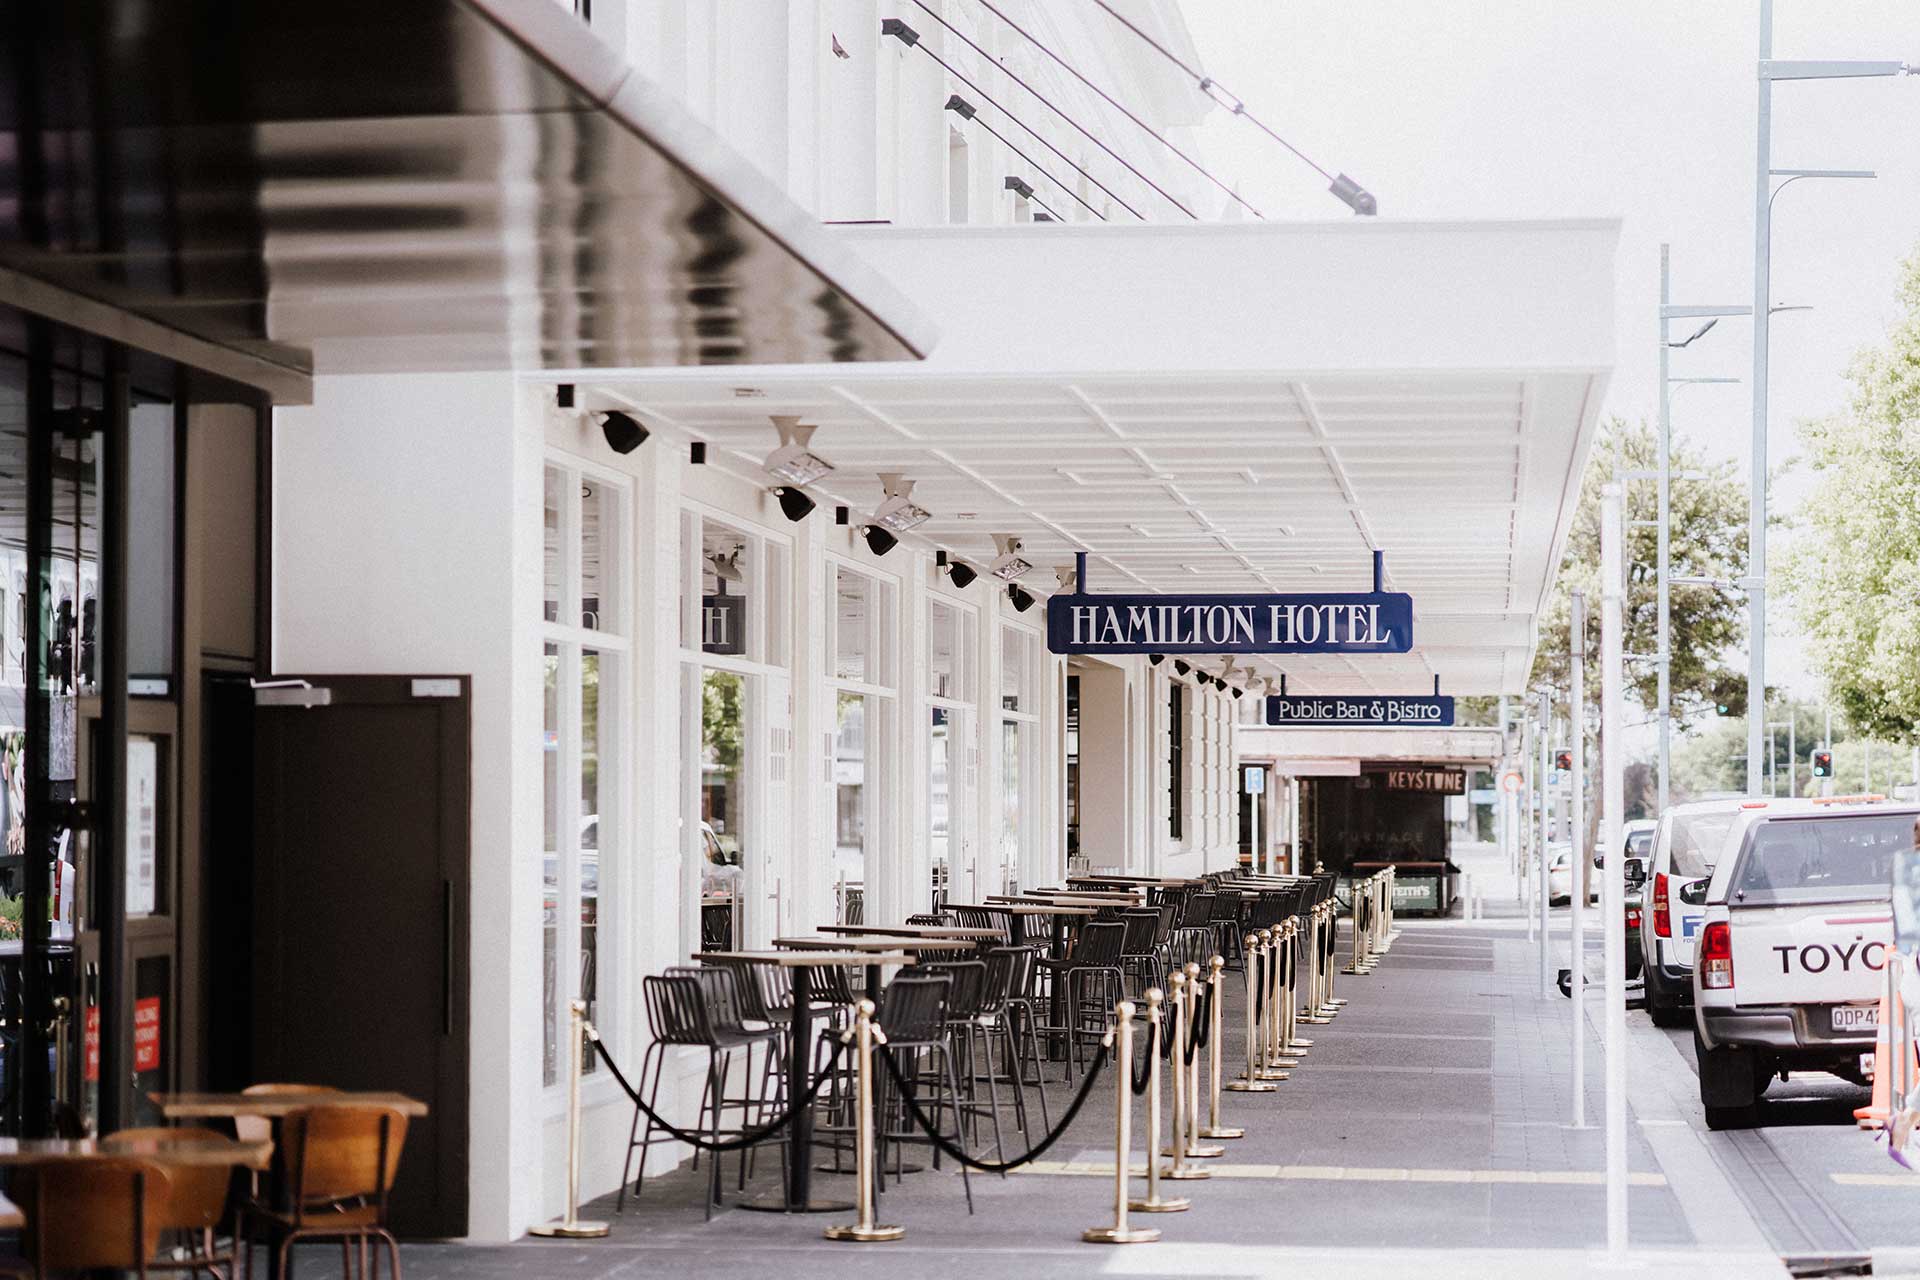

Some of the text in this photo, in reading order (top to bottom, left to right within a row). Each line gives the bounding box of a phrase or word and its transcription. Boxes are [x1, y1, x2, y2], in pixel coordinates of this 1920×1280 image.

[1070, 604, 1391, 644] HAMILTON HOTEL
[1279, 701, 1441, 722] Public Bar & Bistro
[1388, 770, 1463, 790] KEYSTONE
[1392, 885, 1431, 897] TEITH'S
[1772, 941, 1886, 974] TOYO
